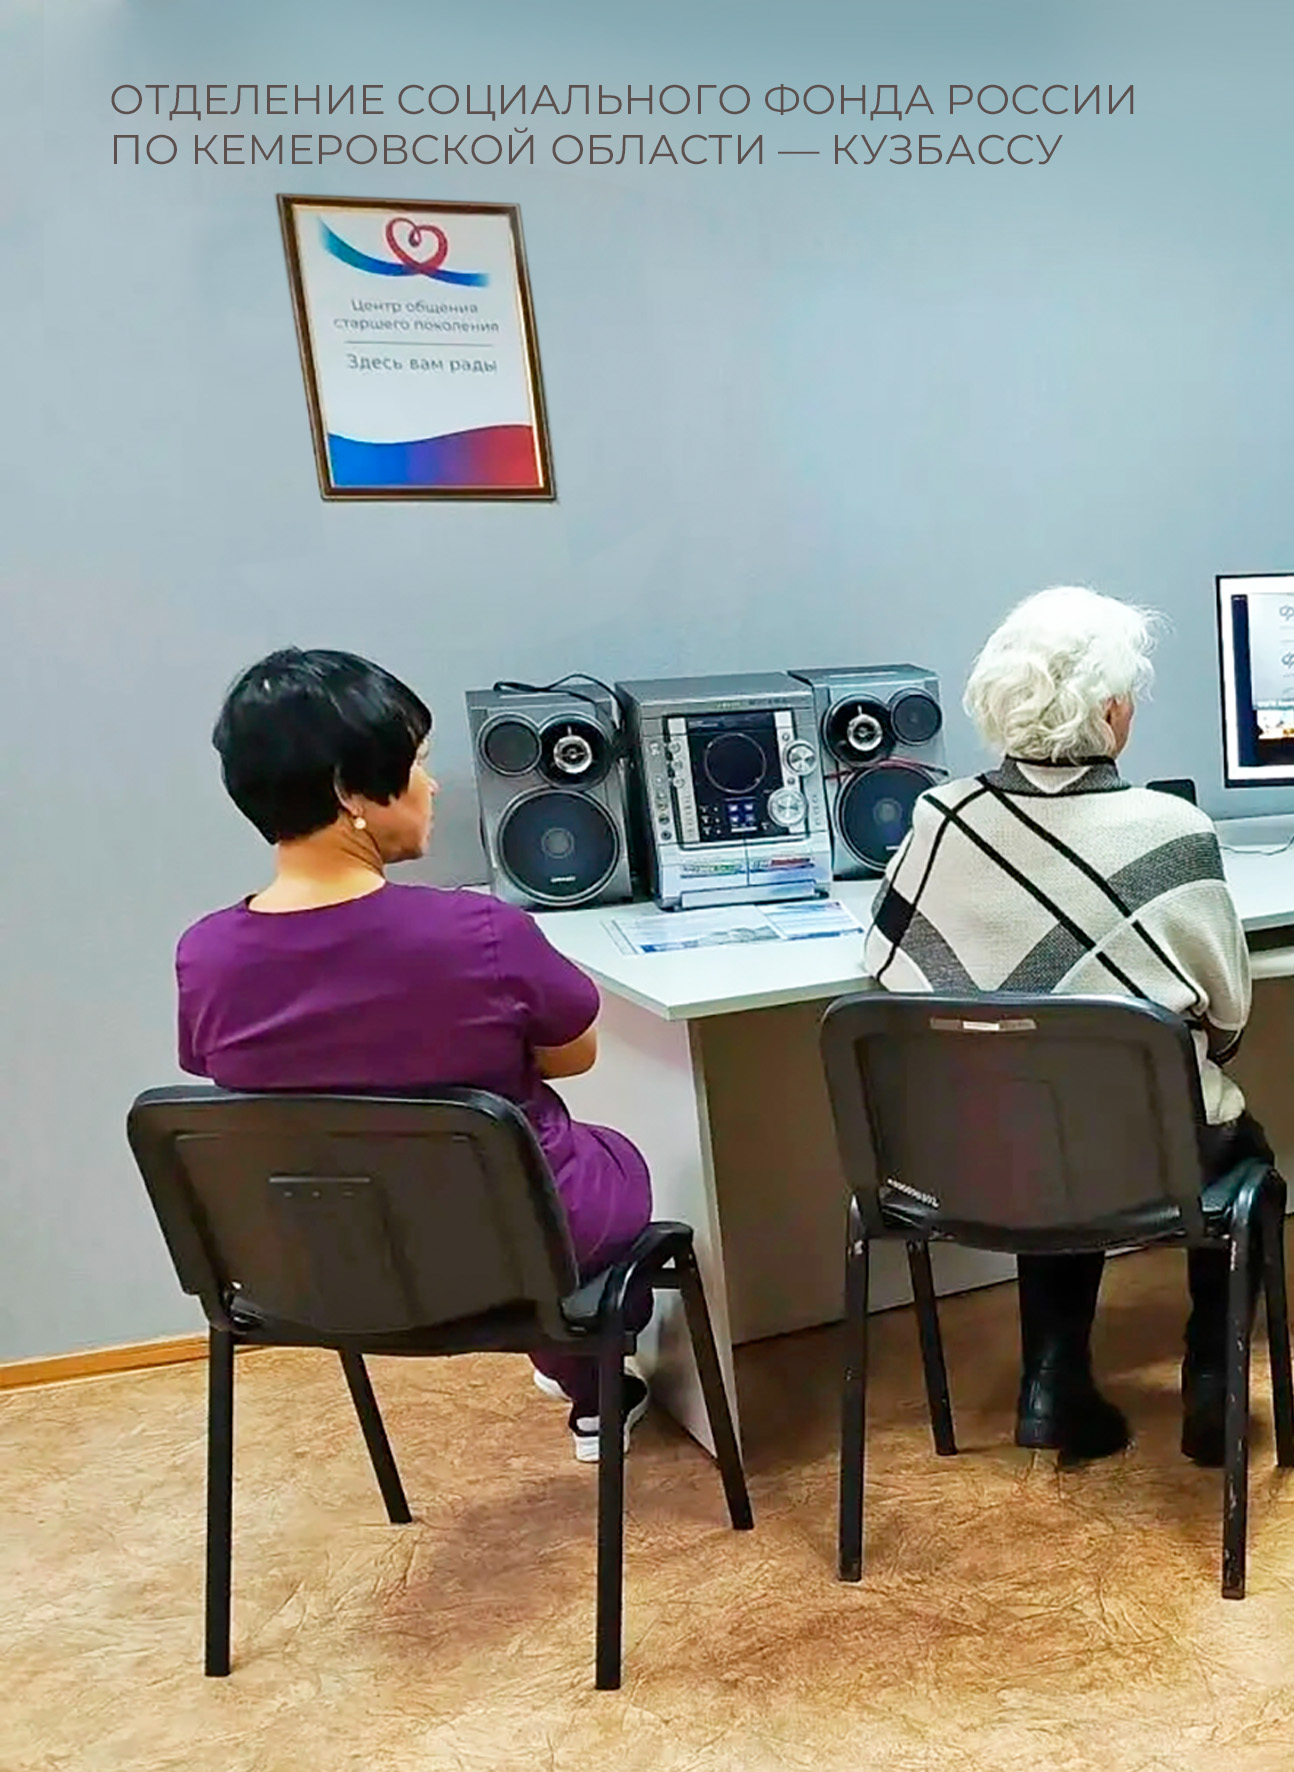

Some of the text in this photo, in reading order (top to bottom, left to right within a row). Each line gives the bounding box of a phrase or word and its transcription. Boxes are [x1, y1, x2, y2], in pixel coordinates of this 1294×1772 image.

[351, 299, 478, 314] Центр общения
[333, 318, 499, 333] старшего поколения
[346, 353, 497, 374] Здесь вам рады
